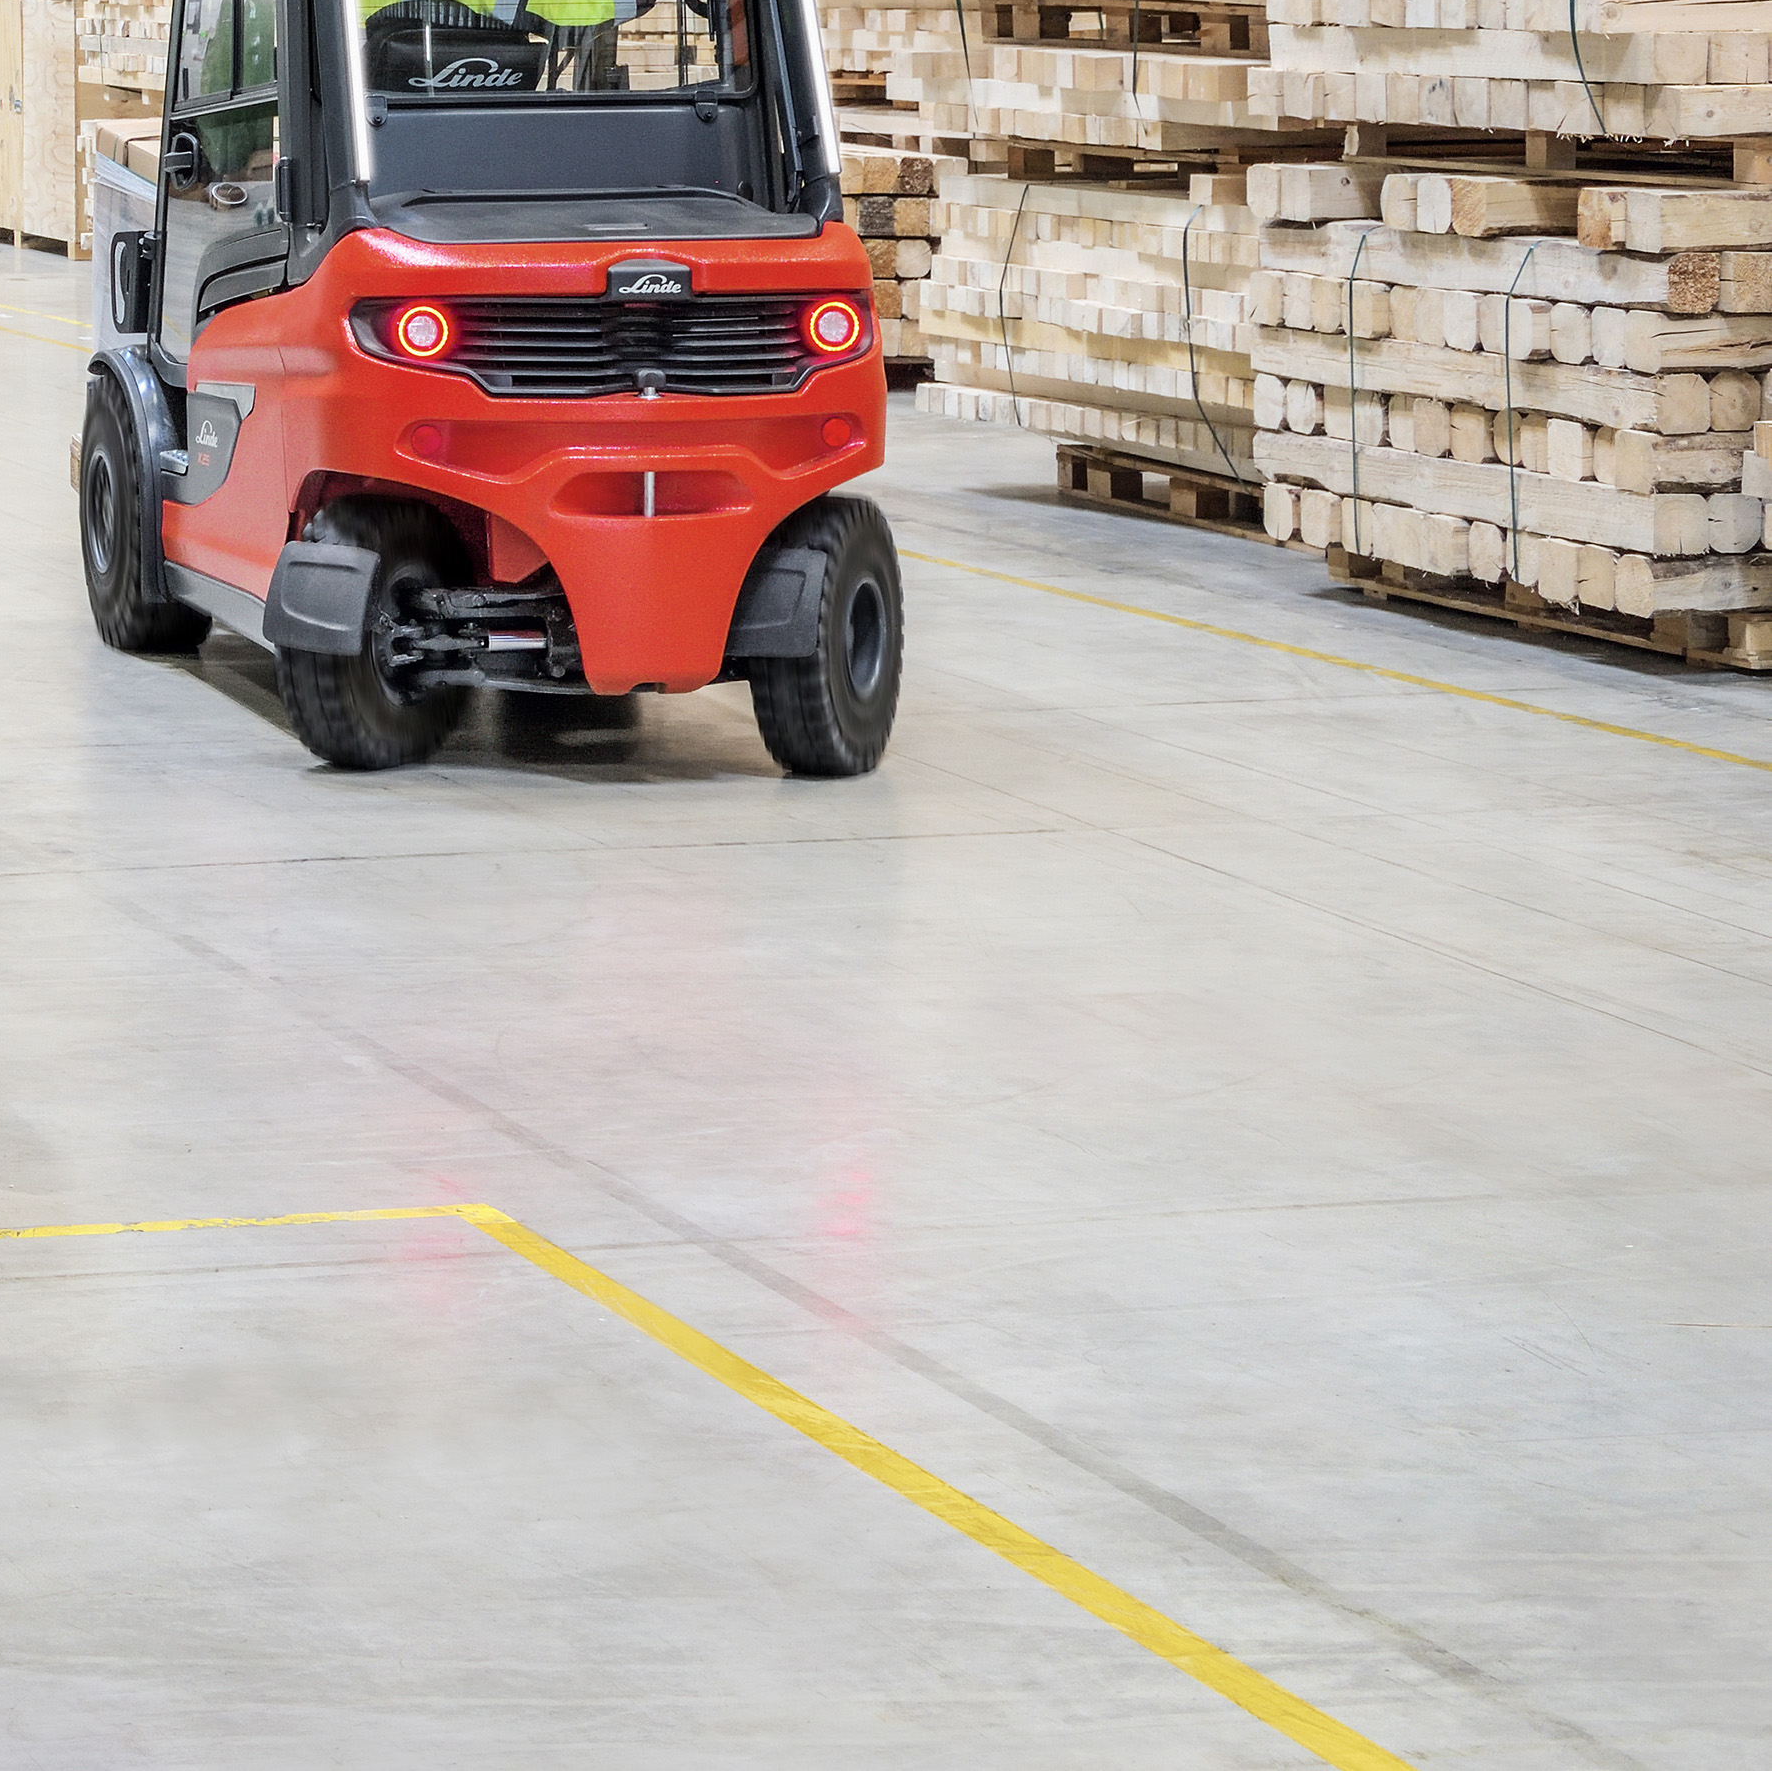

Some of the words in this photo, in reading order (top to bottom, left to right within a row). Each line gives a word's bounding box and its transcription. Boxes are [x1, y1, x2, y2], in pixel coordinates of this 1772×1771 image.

[408, 56, 524, 89] Linde
[618, 274, 682, 294] Linde
[195, 419, 218, 448] Linde
